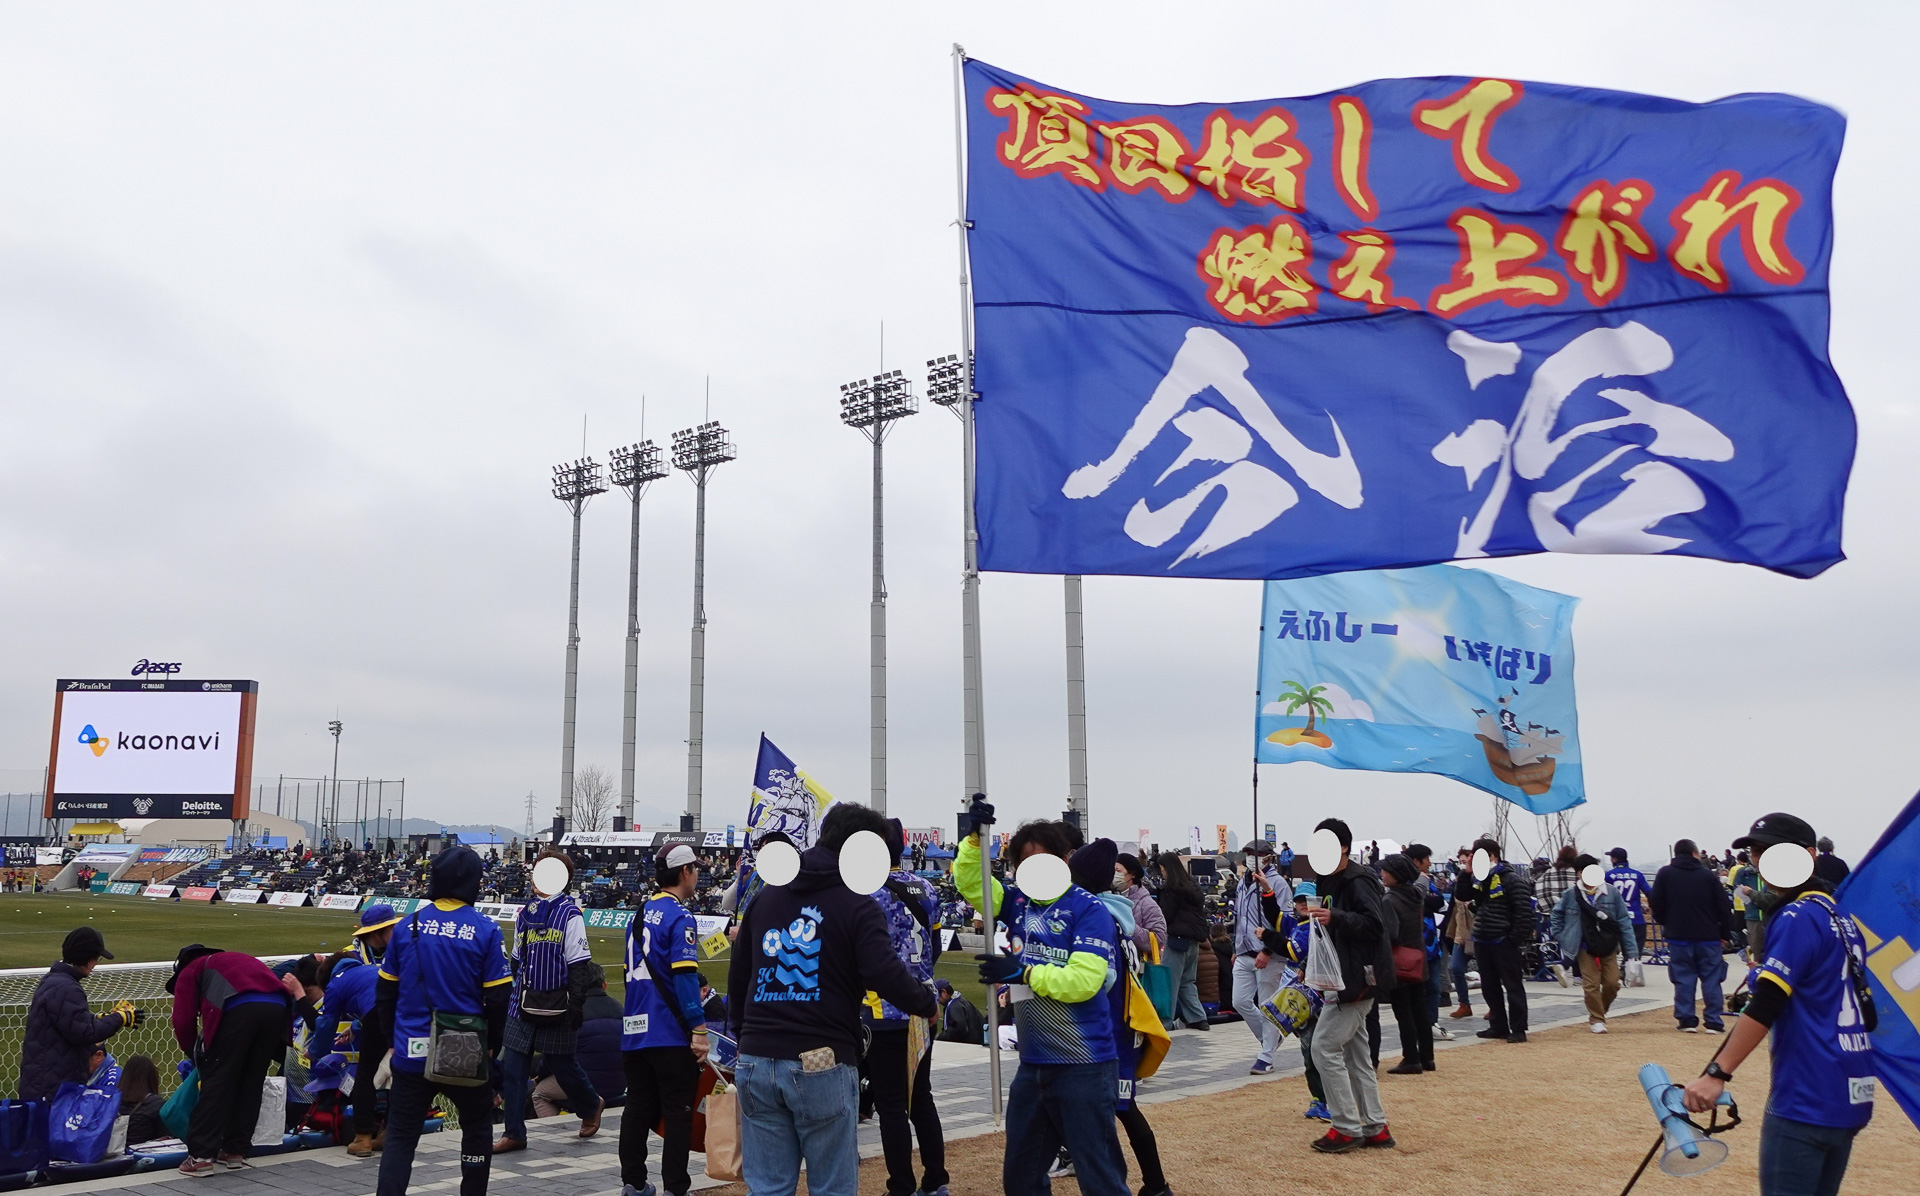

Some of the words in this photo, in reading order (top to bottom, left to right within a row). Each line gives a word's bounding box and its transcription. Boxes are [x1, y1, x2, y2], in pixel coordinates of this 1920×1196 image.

[988, 78, 1519, 219] 頂目指して
[1200, 169, 1804, 324] 燃え上がれ
[1061, 319, 1735, 571] 今治
[1276, 609, 1399, 643] えふしー
[131, 658, 182, 676] asics
[1443, 635, 1552, 685] いまばり
[117, 731, 220, 750] kaonavi
[182, 801, 223, 810] Deloitte.
[1025, 942, 1069, 960] unicharm
[754, 983, 821, 1002] Imabari
